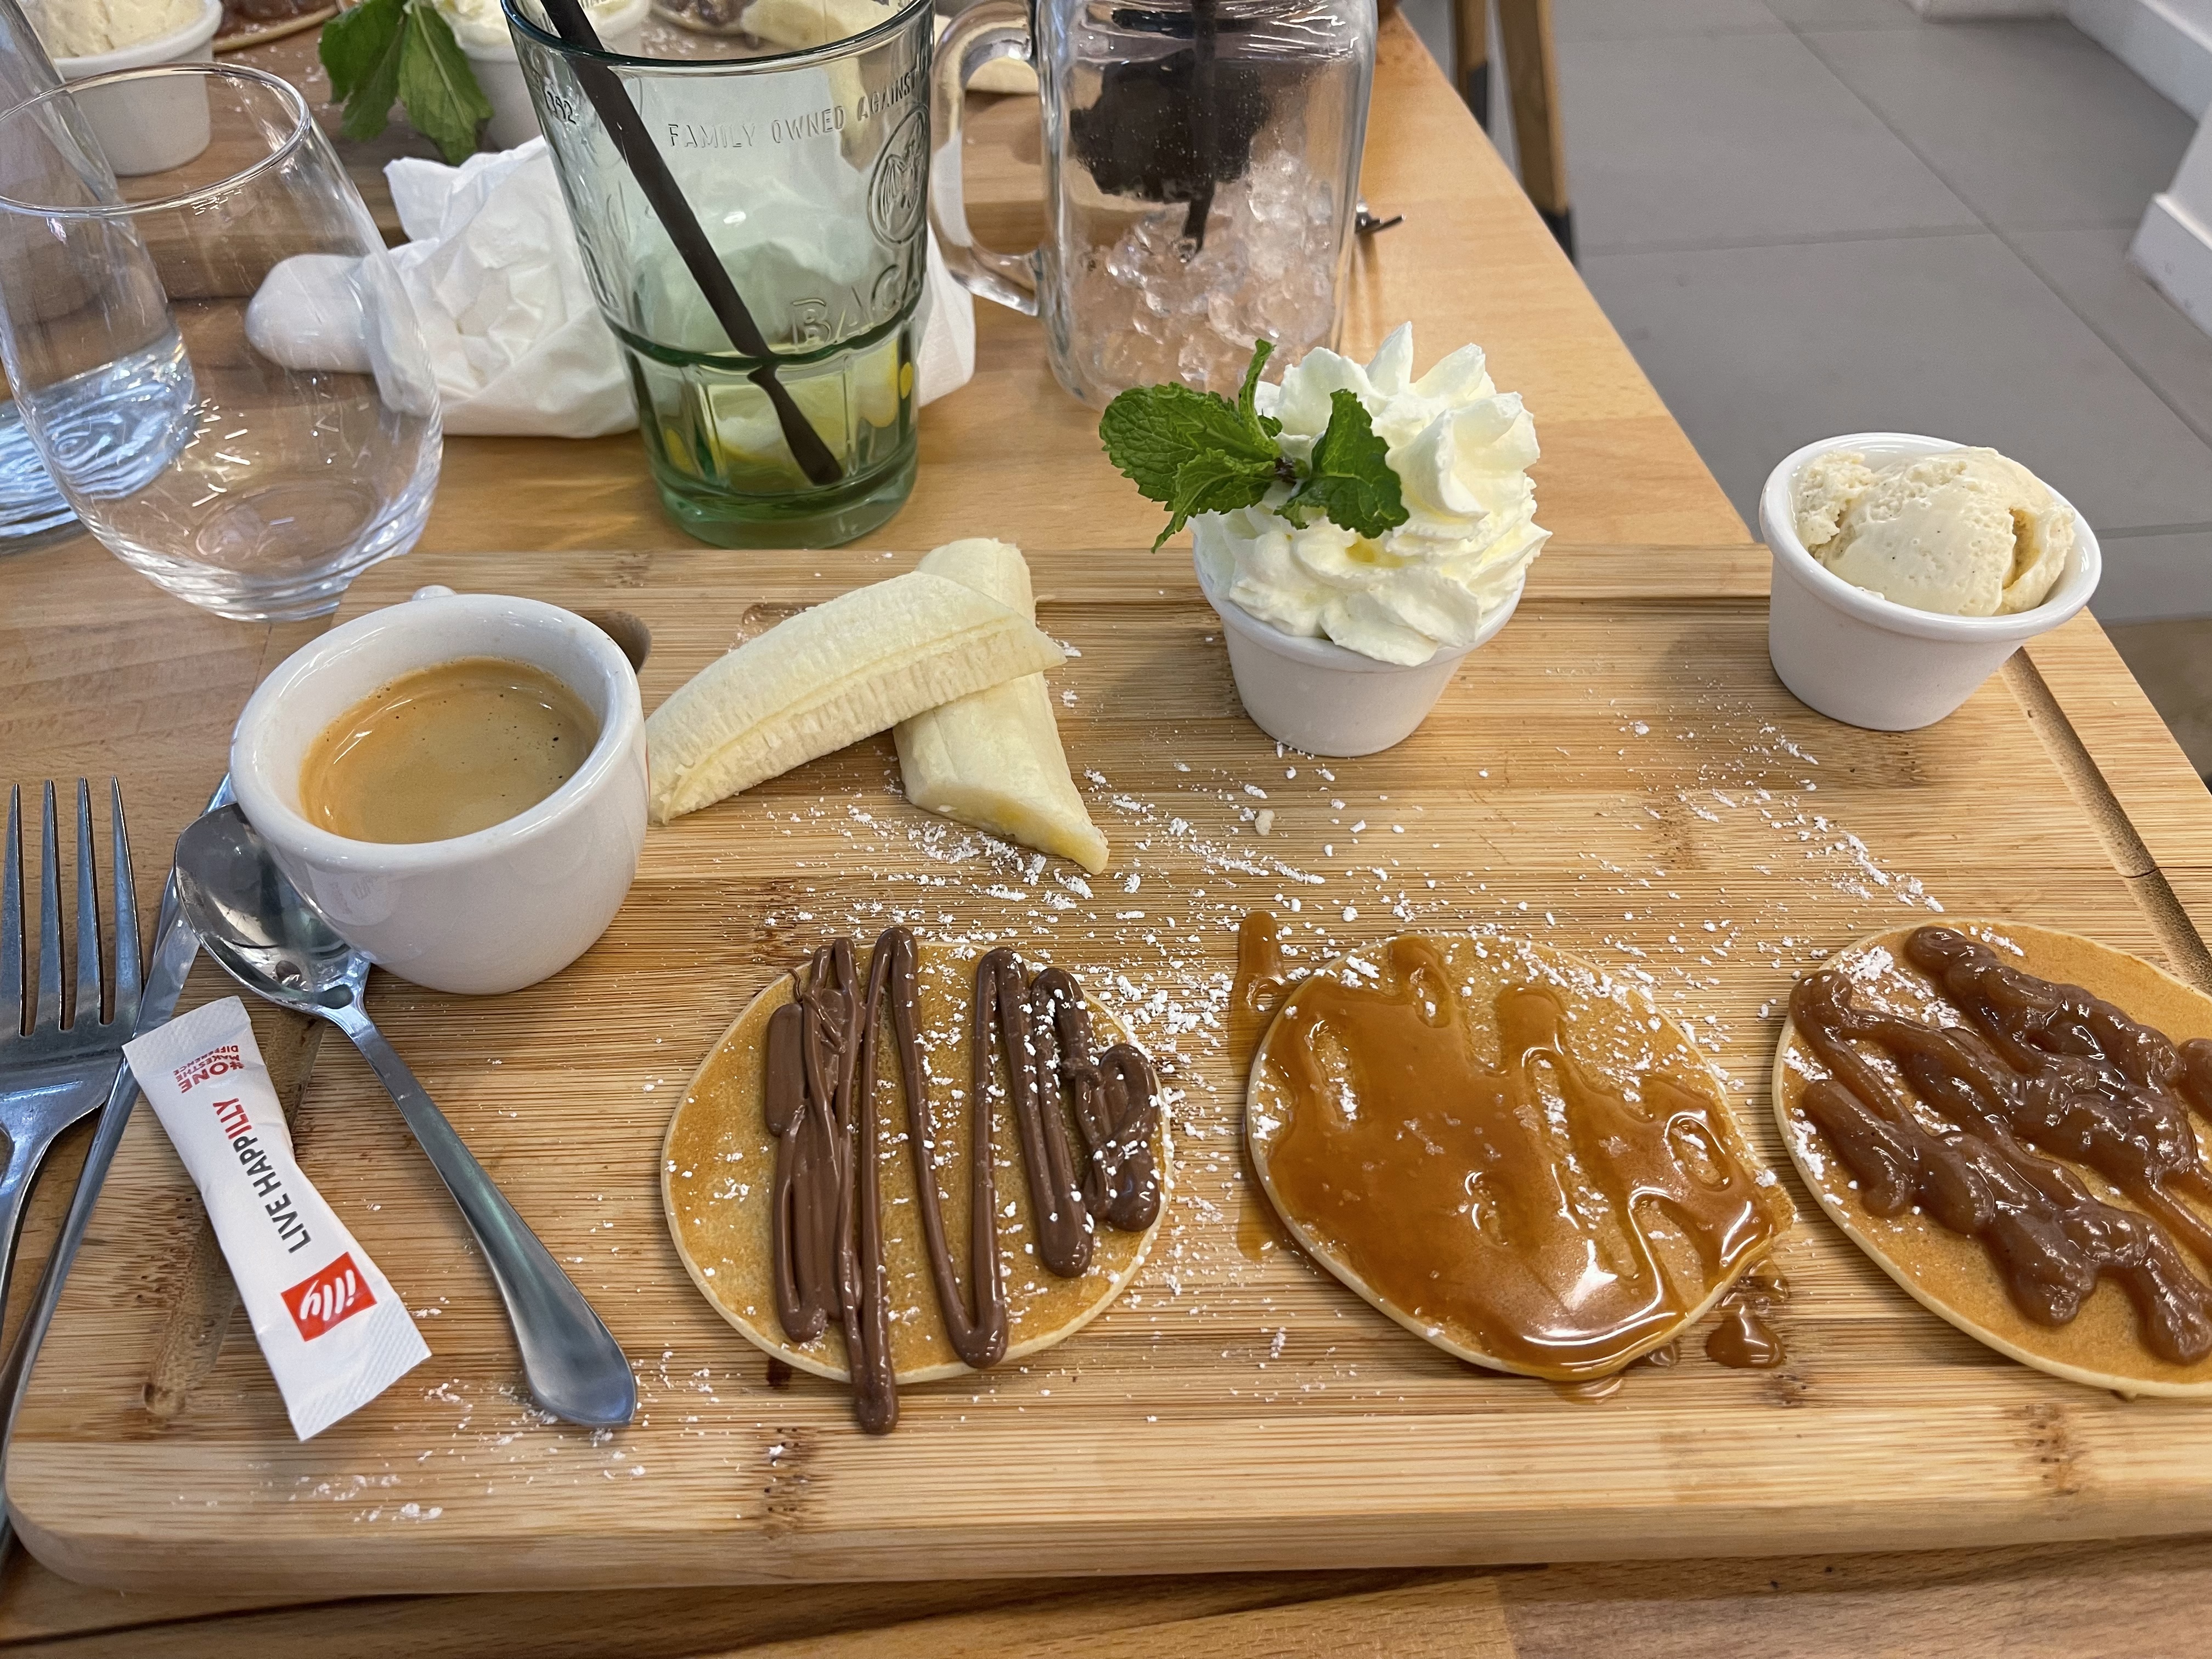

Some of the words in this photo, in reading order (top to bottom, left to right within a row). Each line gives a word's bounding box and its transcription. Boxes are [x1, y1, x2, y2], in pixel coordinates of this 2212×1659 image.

[668, 123, 755, 148] FAMILY
[772, 106, 844, 144] OWNED
[793, 264, 922, 346] BAC
[173, 1045, 239, 1076] DIFFERENCE
[178, 1061, 245, 1093] #ONE
[212, 1098, 282, 1198] HAPPILLY
[265, 1193, 311, 1254] LIVE
[300, 1269, 356, 1321] illy
